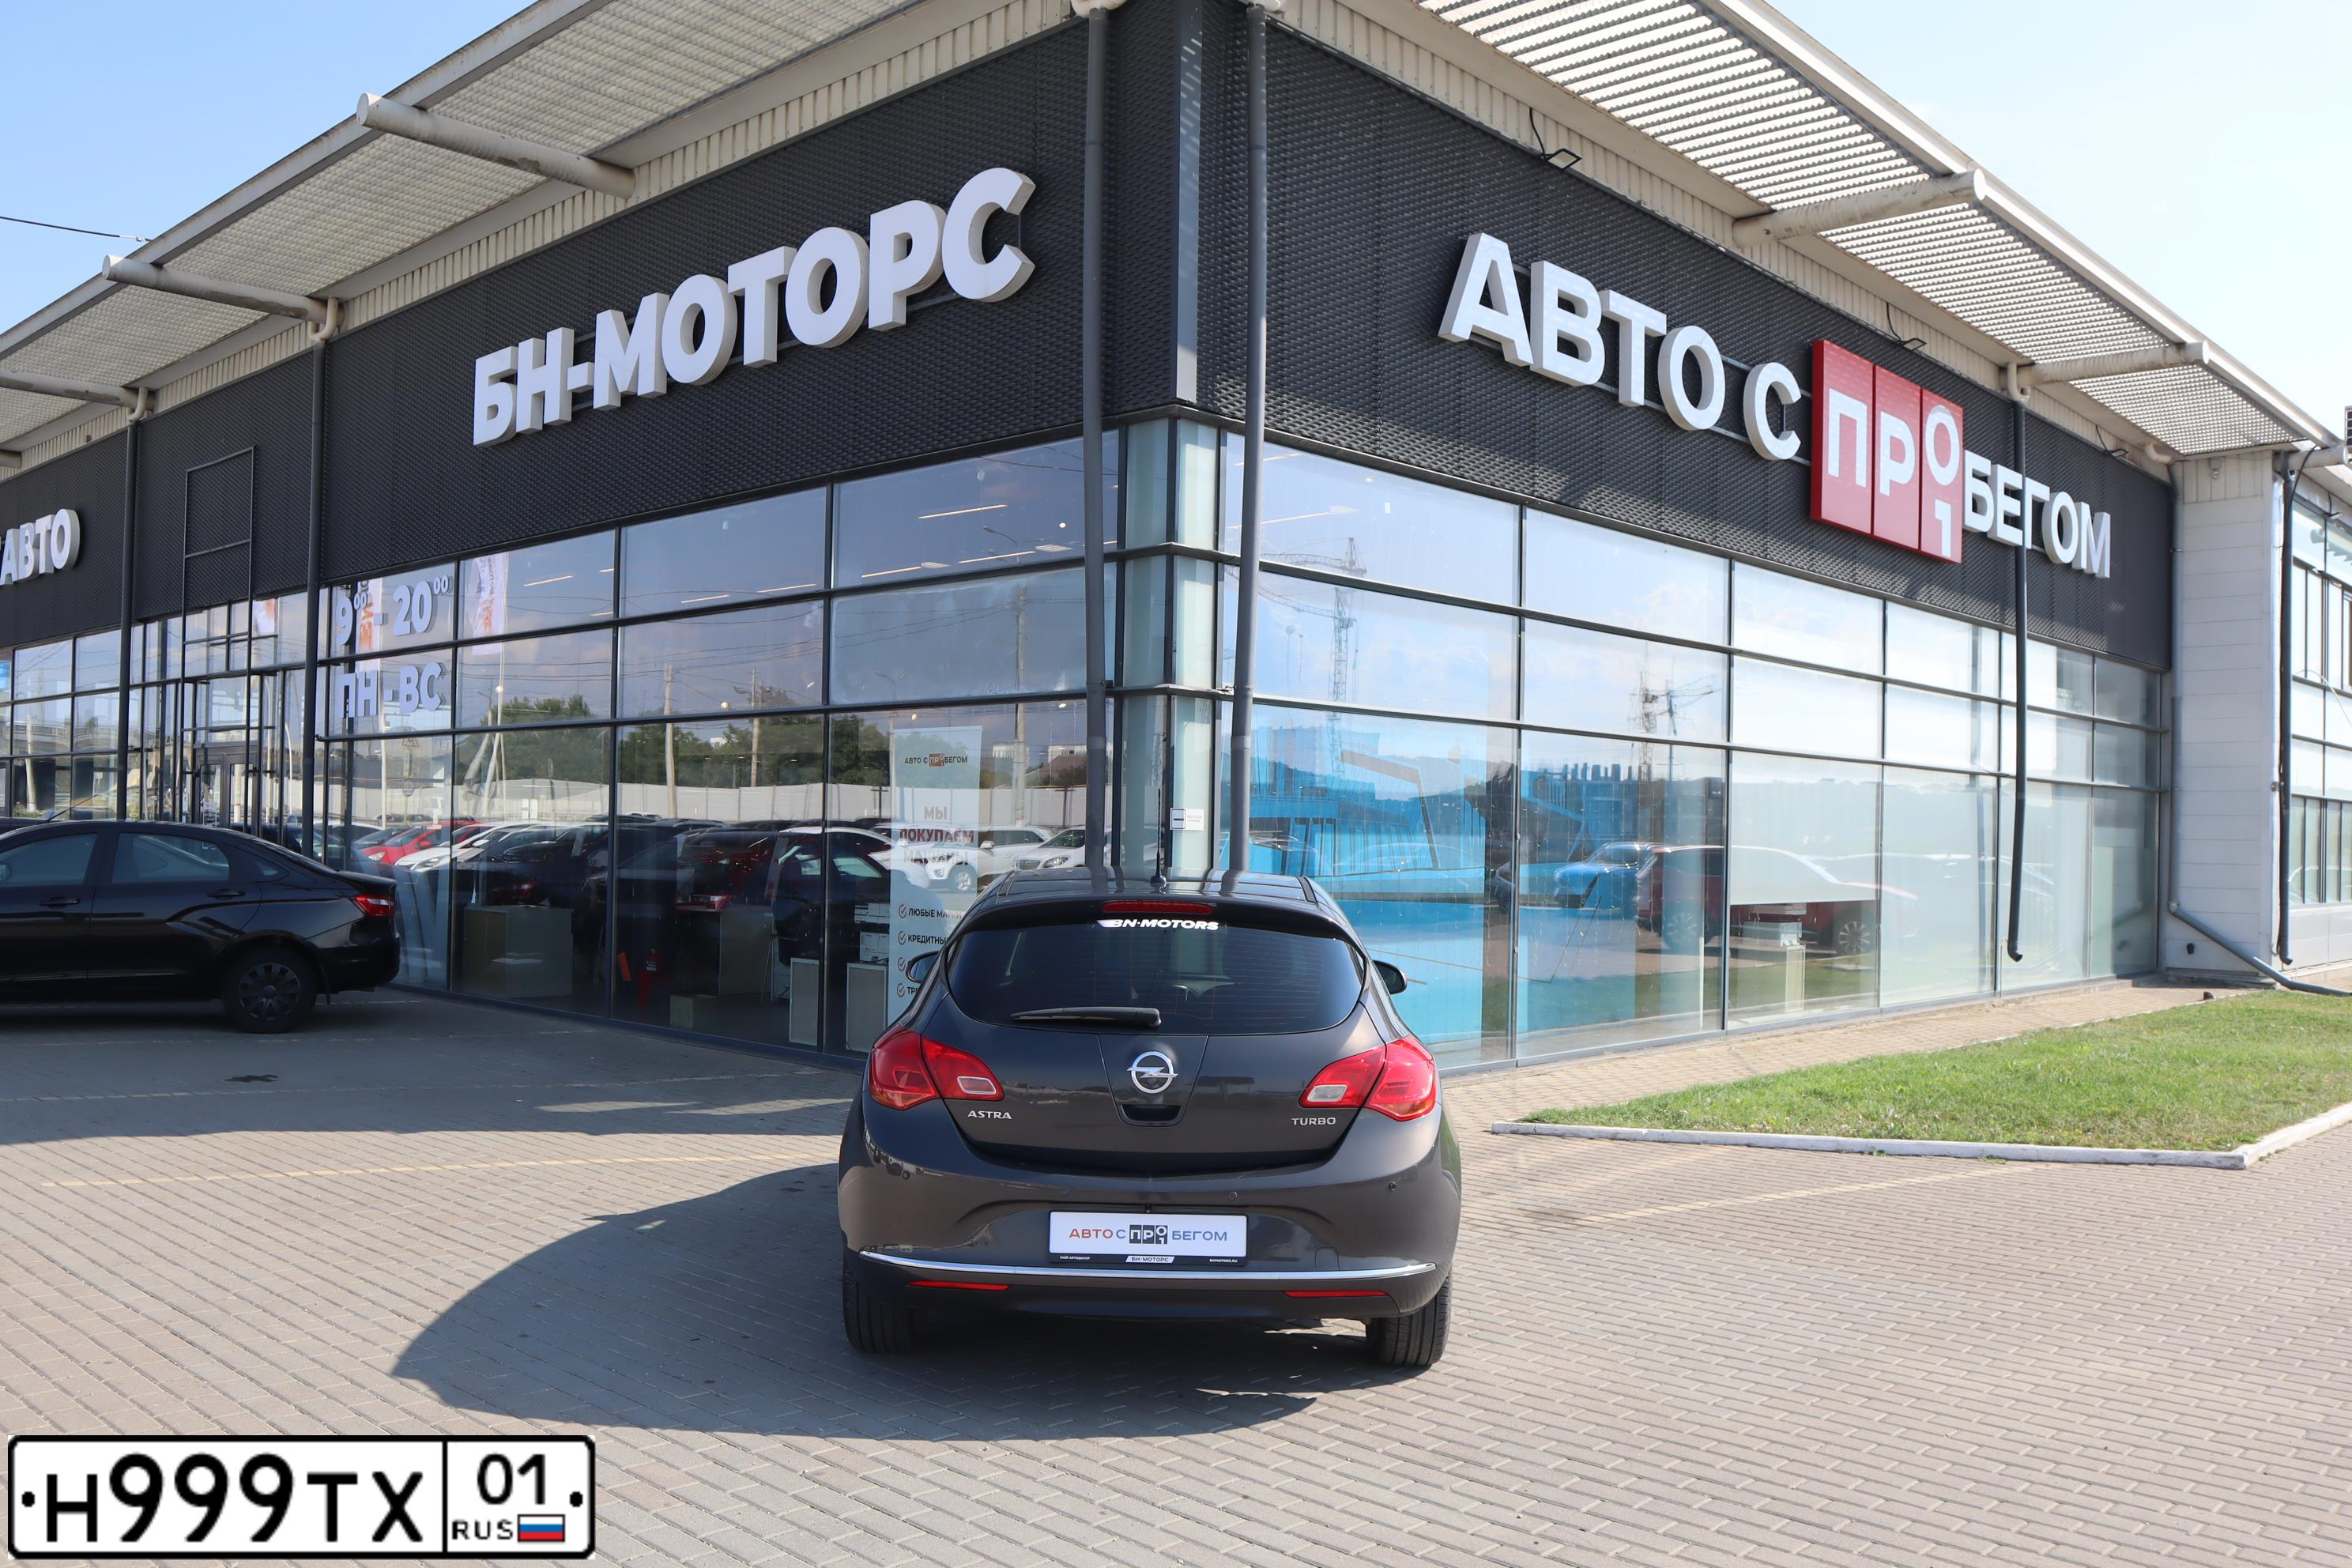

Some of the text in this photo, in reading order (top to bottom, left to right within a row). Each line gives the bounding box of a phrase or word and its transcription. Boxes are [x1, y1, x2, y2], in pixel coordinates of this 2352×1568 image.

[473, 167, 1036, 447] БН-МОТОРС
[1438, 232, 1726, 432] АВТО
[1743, 361, 1802, 461] С
[0, 508, 81, 586] АВТО
[924, 806, 948, 820] МЫ
[900, 827, 974, 843] ПОКУПАЕМ
[908, 908, 936, 918] ЛЮБЫЕ
[908, 934, 948, 945] КРЕДИТНЫ
[967, 1110, 1012, 1120] ASTRA
[1291, 1117, 1336, 1125] TURBO
[1069, 1228, 1114, 1239] АВТО
[1116, 1229, 1126, 1239] С
